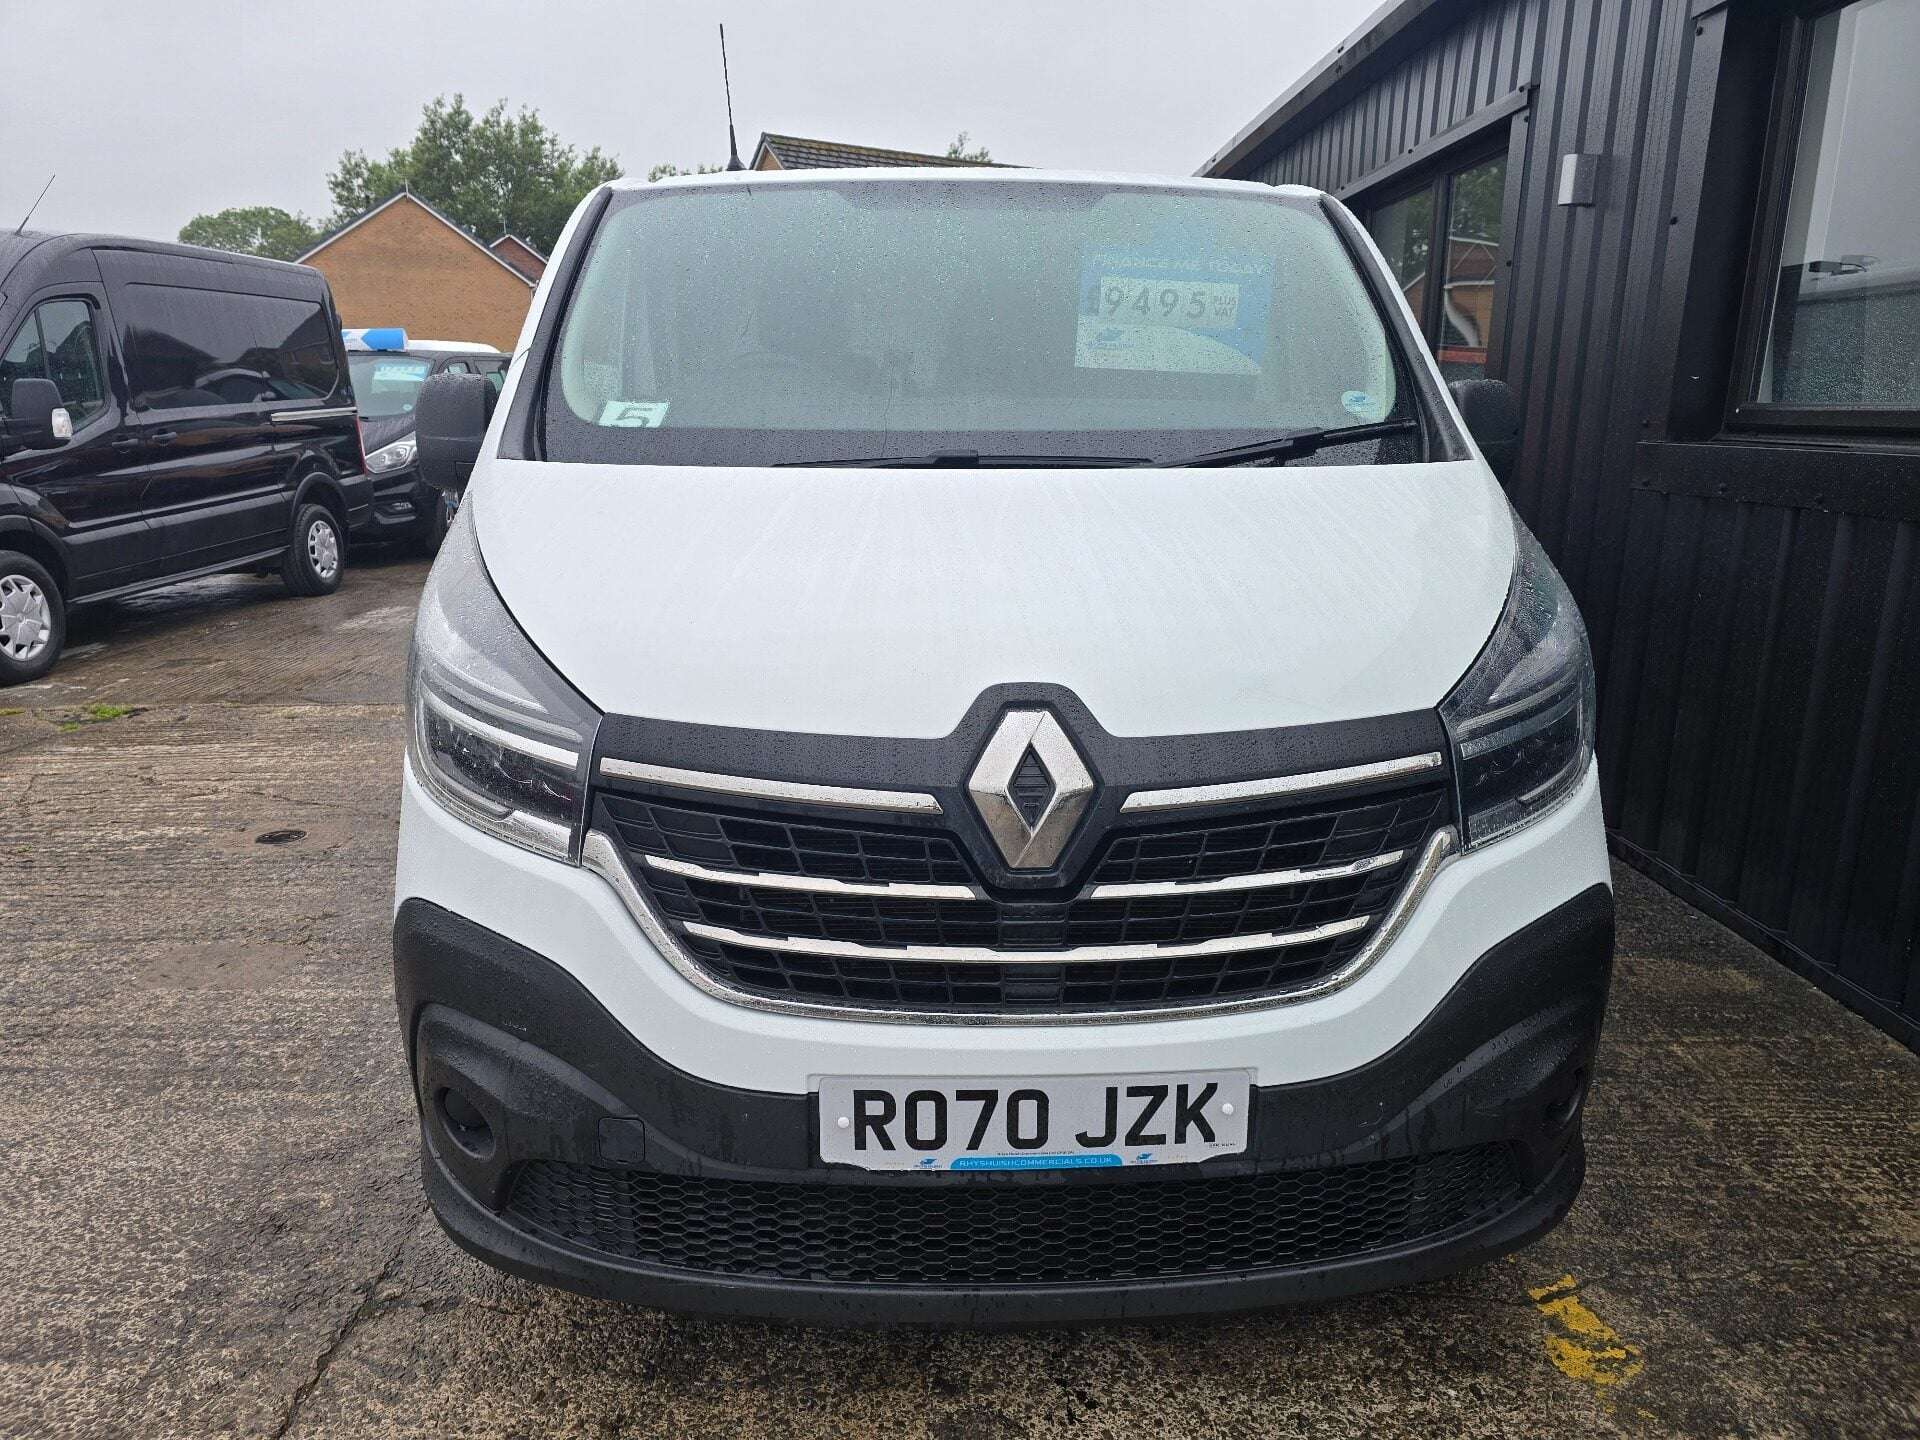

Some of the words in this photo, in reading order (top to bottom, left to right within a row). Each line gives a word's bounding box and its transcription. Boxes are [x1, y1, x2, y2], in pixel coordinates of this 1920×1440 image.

[1214, 306, 1234, 317] VAT
[616, 407, 653, 428] 5
[853, 1088, 1050, 1151] RO70
[1075, 1082, 1219, 1148] JZK
